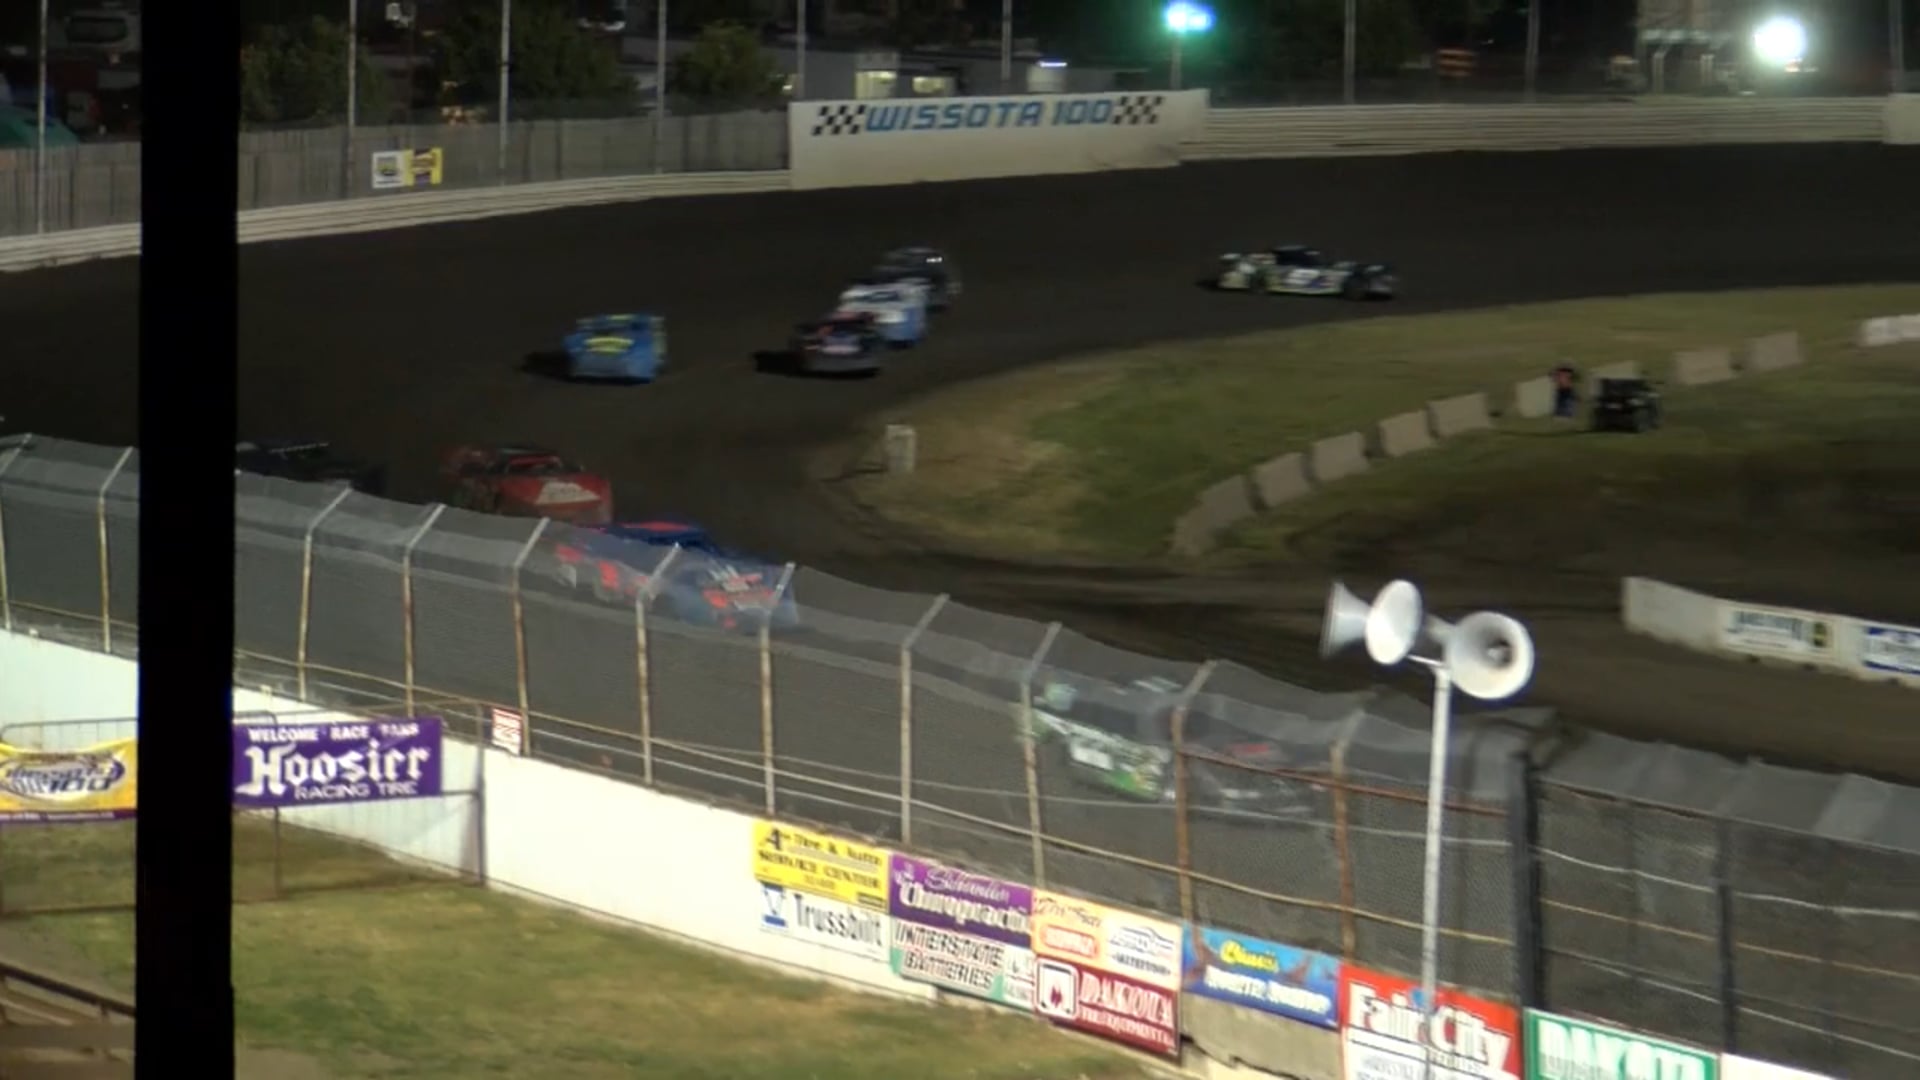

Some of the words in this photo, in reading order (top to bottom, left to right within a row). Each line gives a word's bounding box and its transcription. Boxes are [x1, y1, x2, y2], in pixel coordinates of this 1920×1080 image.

[866, 102, 1043, 131] WISSOTA
[1052, 99, 1113, 125] 100
[248, 726, 319, 742] WELCOME
[330, 724, 370, 740] RACE
[49, 777, 114, 794] 100
[234, 738, 431, 796] Hoosier
[294, 783, 370, 800] RACING
[376, 780, 418, 797] TIRE
[823, 865, 881, 889] CENTER
[794, 893, 882, 946] Trussbilt
[895, 922, 1004, 970] INTERSTATE
[904, 949, 992, 990] BATTERIES
[1080, 971, 1174, 1029] DAKOTA
[1349, 981, 1431, 1044] Fair
[1430, 1003, 1513, 1072] City
